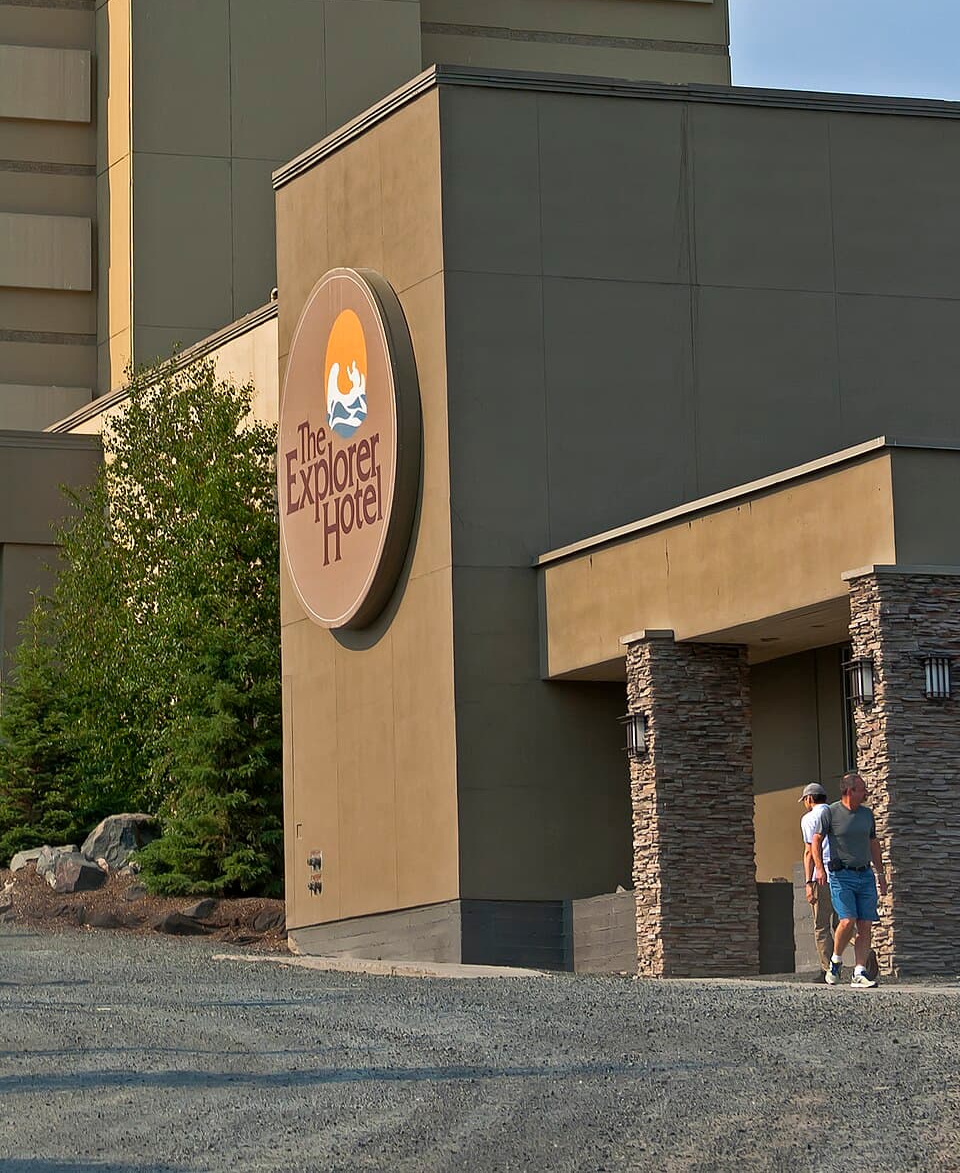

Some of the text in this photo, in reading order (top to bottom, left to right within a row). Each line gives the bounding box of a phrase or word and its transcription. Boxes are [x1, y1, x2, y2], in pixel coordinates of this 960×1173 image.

[285, 433, 380, 523] Explorer
[298, 420, 326, 465] The
[322, 465, 383, 566] Hotel
